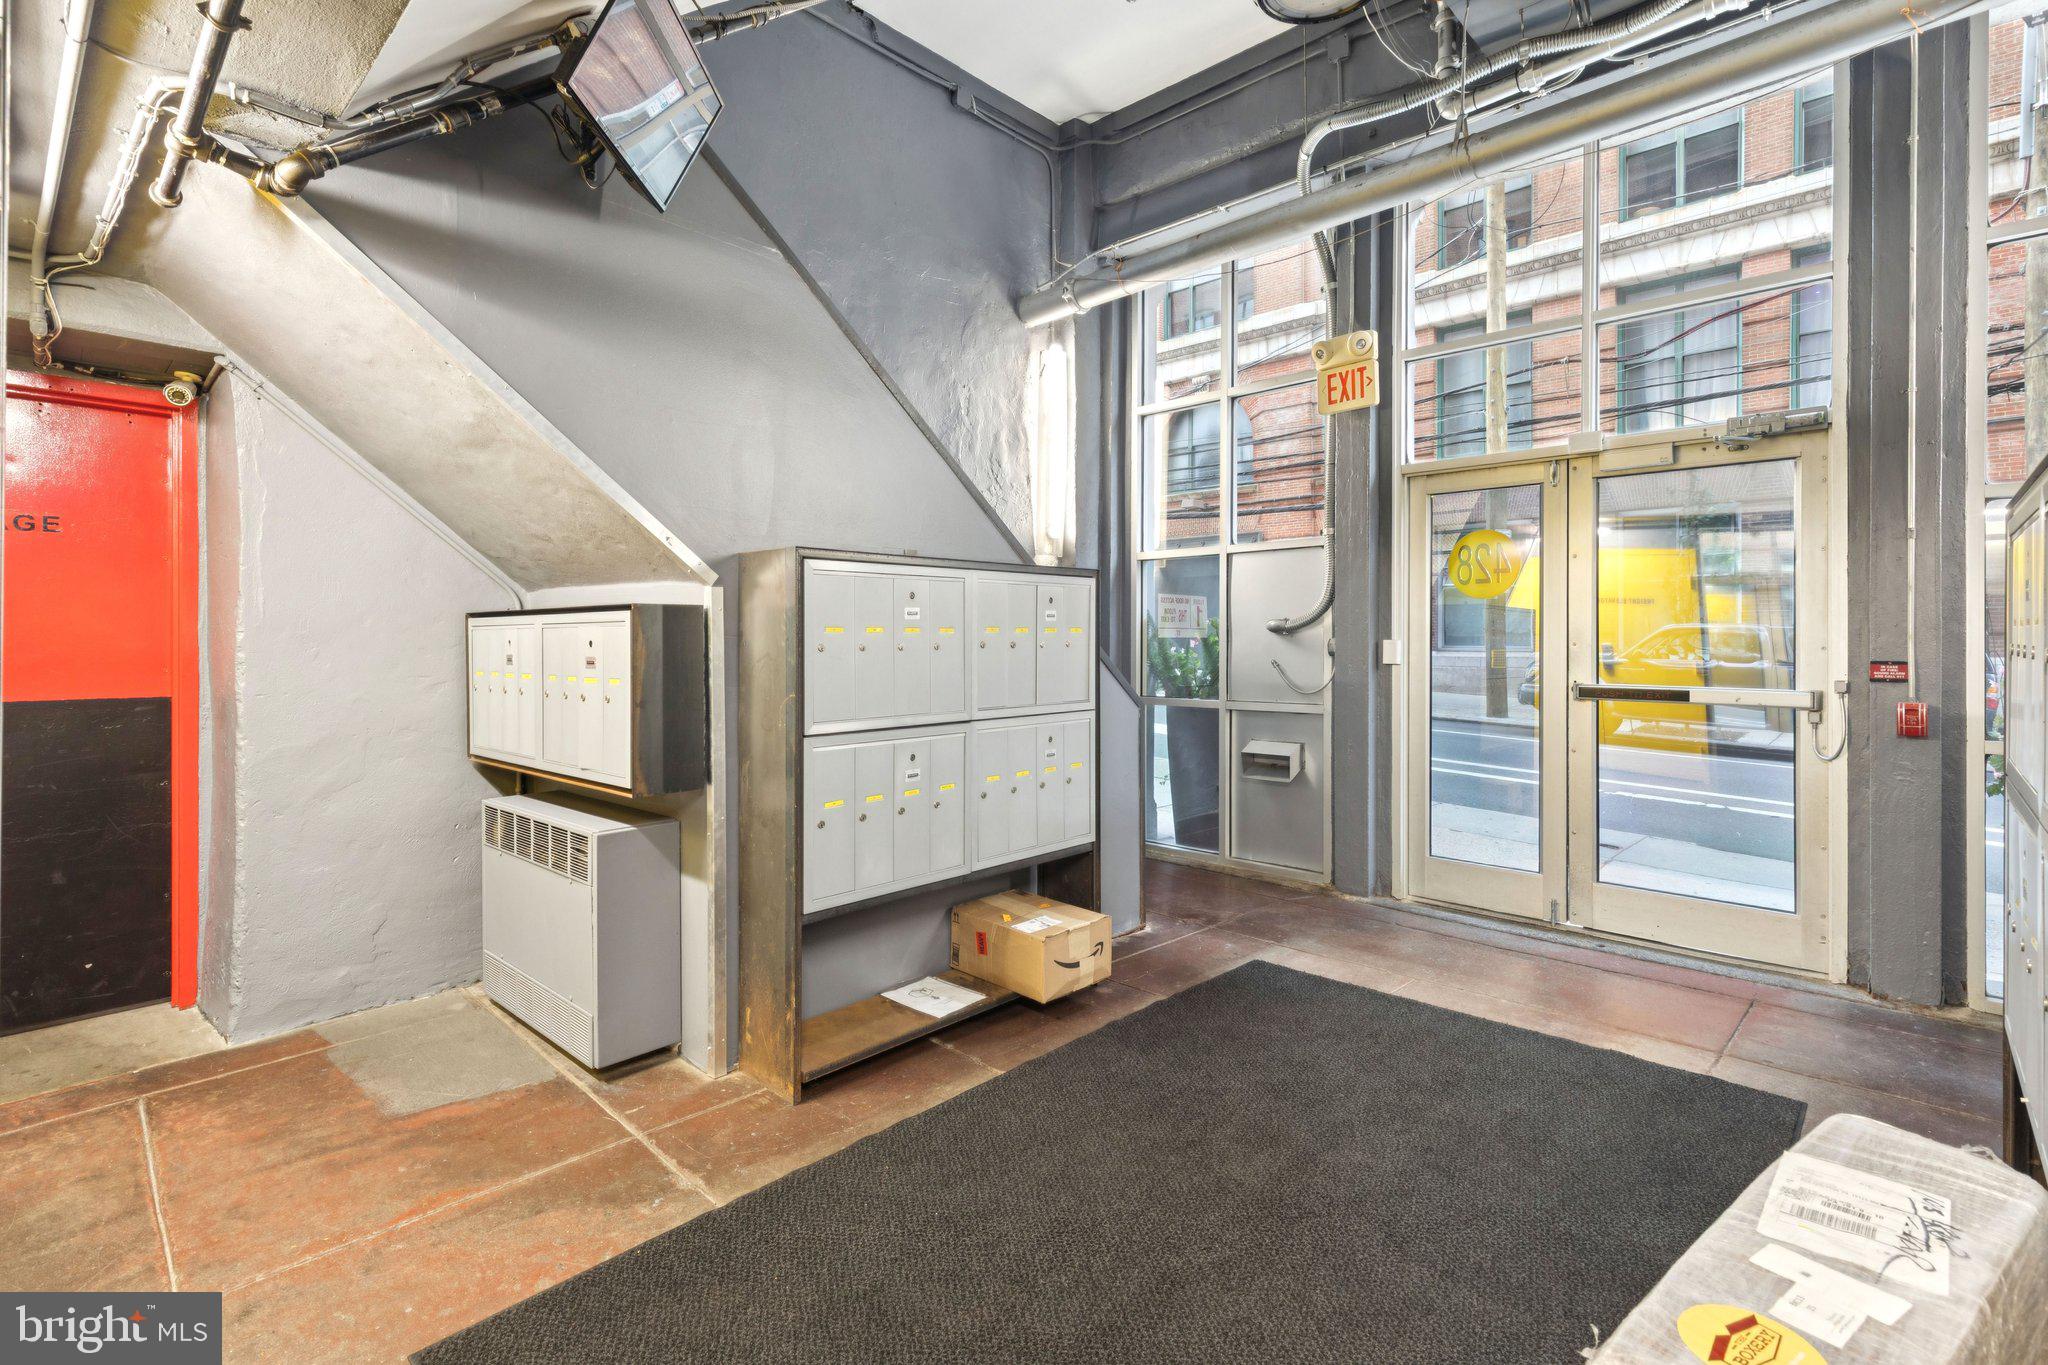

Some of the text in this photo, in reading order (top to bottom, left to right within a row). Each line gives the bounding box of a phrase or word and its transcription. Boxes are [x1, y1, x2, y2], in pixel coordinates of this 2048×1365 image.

[1327, 366, 1367, 405] EXIT
[5, 514, 62, 533] GE
[1596, 688, 1624, 698] PUSH
[1646, 689, 1671, 699] EXIT
[1732, 1329, 1775, 1365] BOXERY
